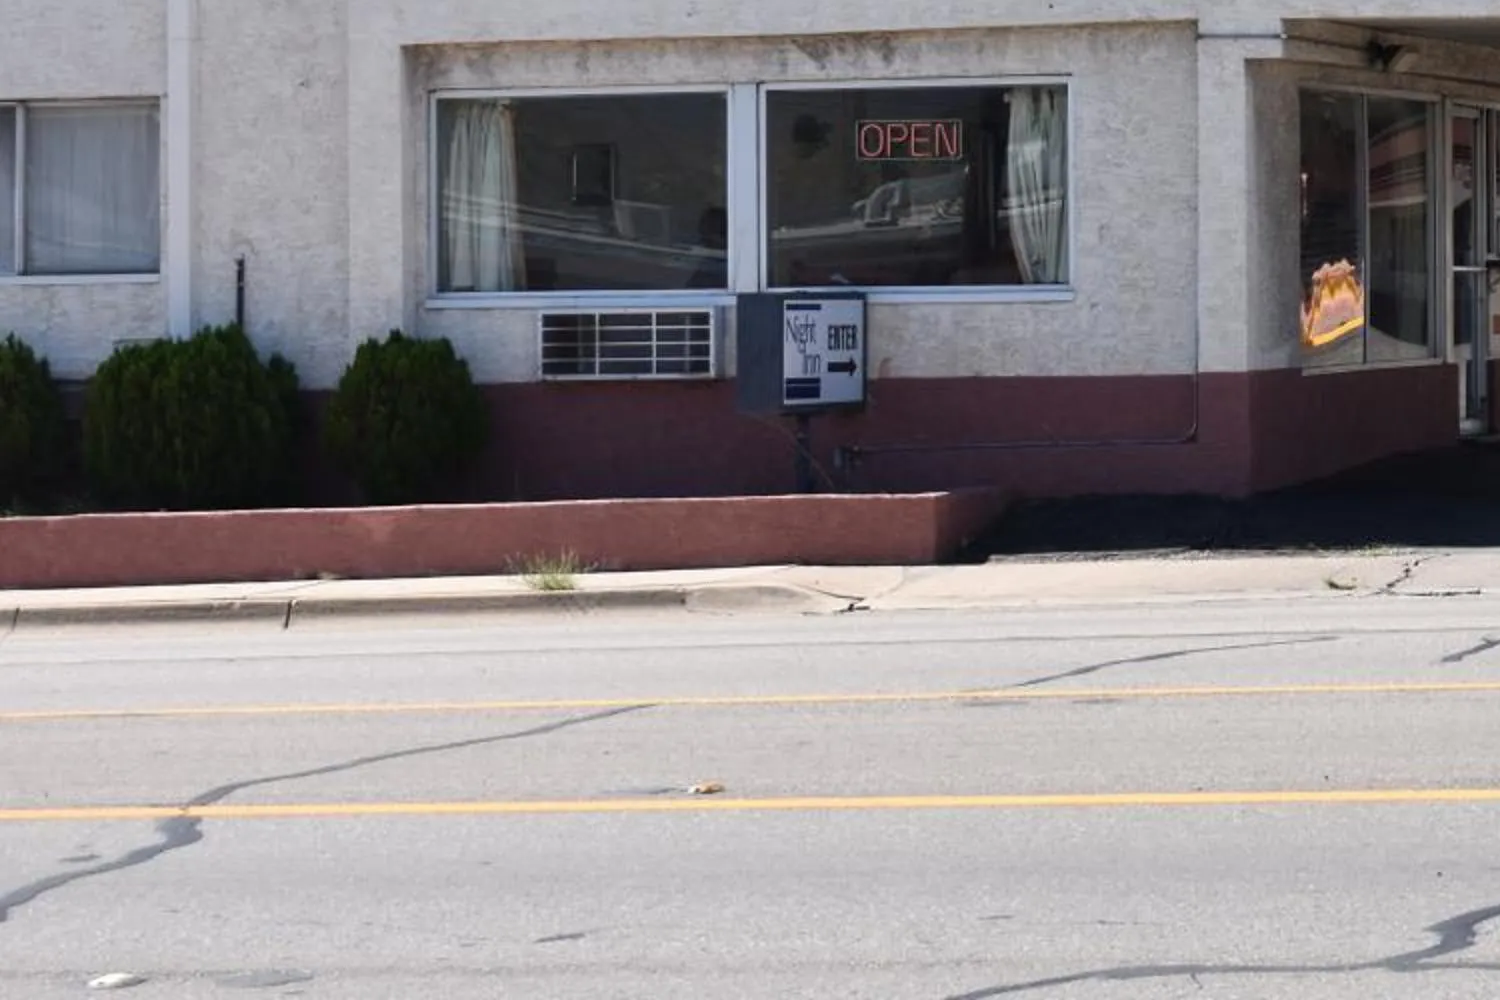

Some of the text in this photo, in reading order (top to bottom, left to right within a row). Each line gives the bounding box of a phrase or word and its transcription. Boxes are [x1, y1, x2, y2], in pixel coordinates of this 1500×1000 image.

[859, 123, 958, 157] OPEN
[785, 313, 817, 354] Night
[827, 325, 857, 350] ENTER
[803, 354, 821, 376] Inn
